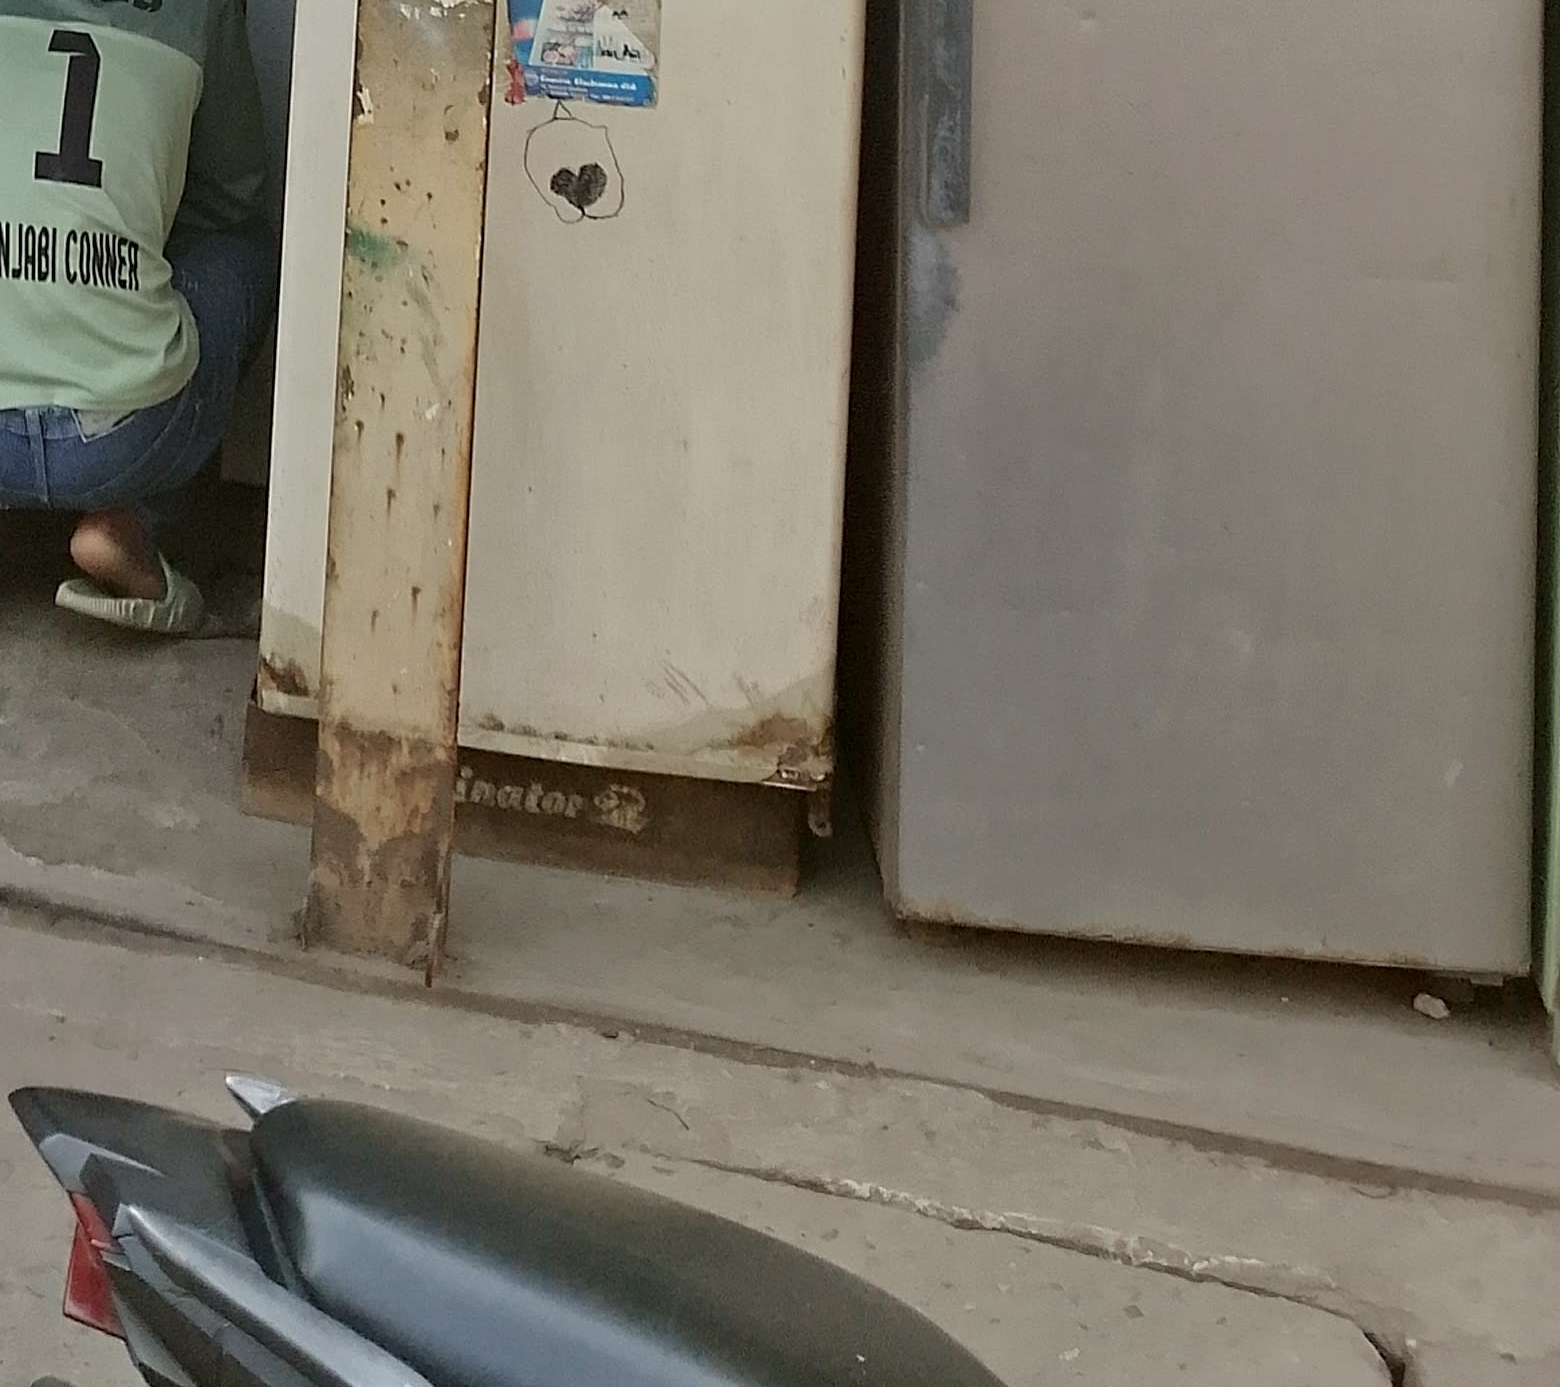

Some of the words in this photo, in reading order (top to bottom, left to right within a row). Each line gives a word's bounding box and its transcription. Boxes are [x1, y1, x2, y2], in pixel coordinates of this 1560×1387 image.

[33, 28, 104, 189] 1
[64, 229, 141, 292] CONNER
[454, 765, 588, 819] inator
